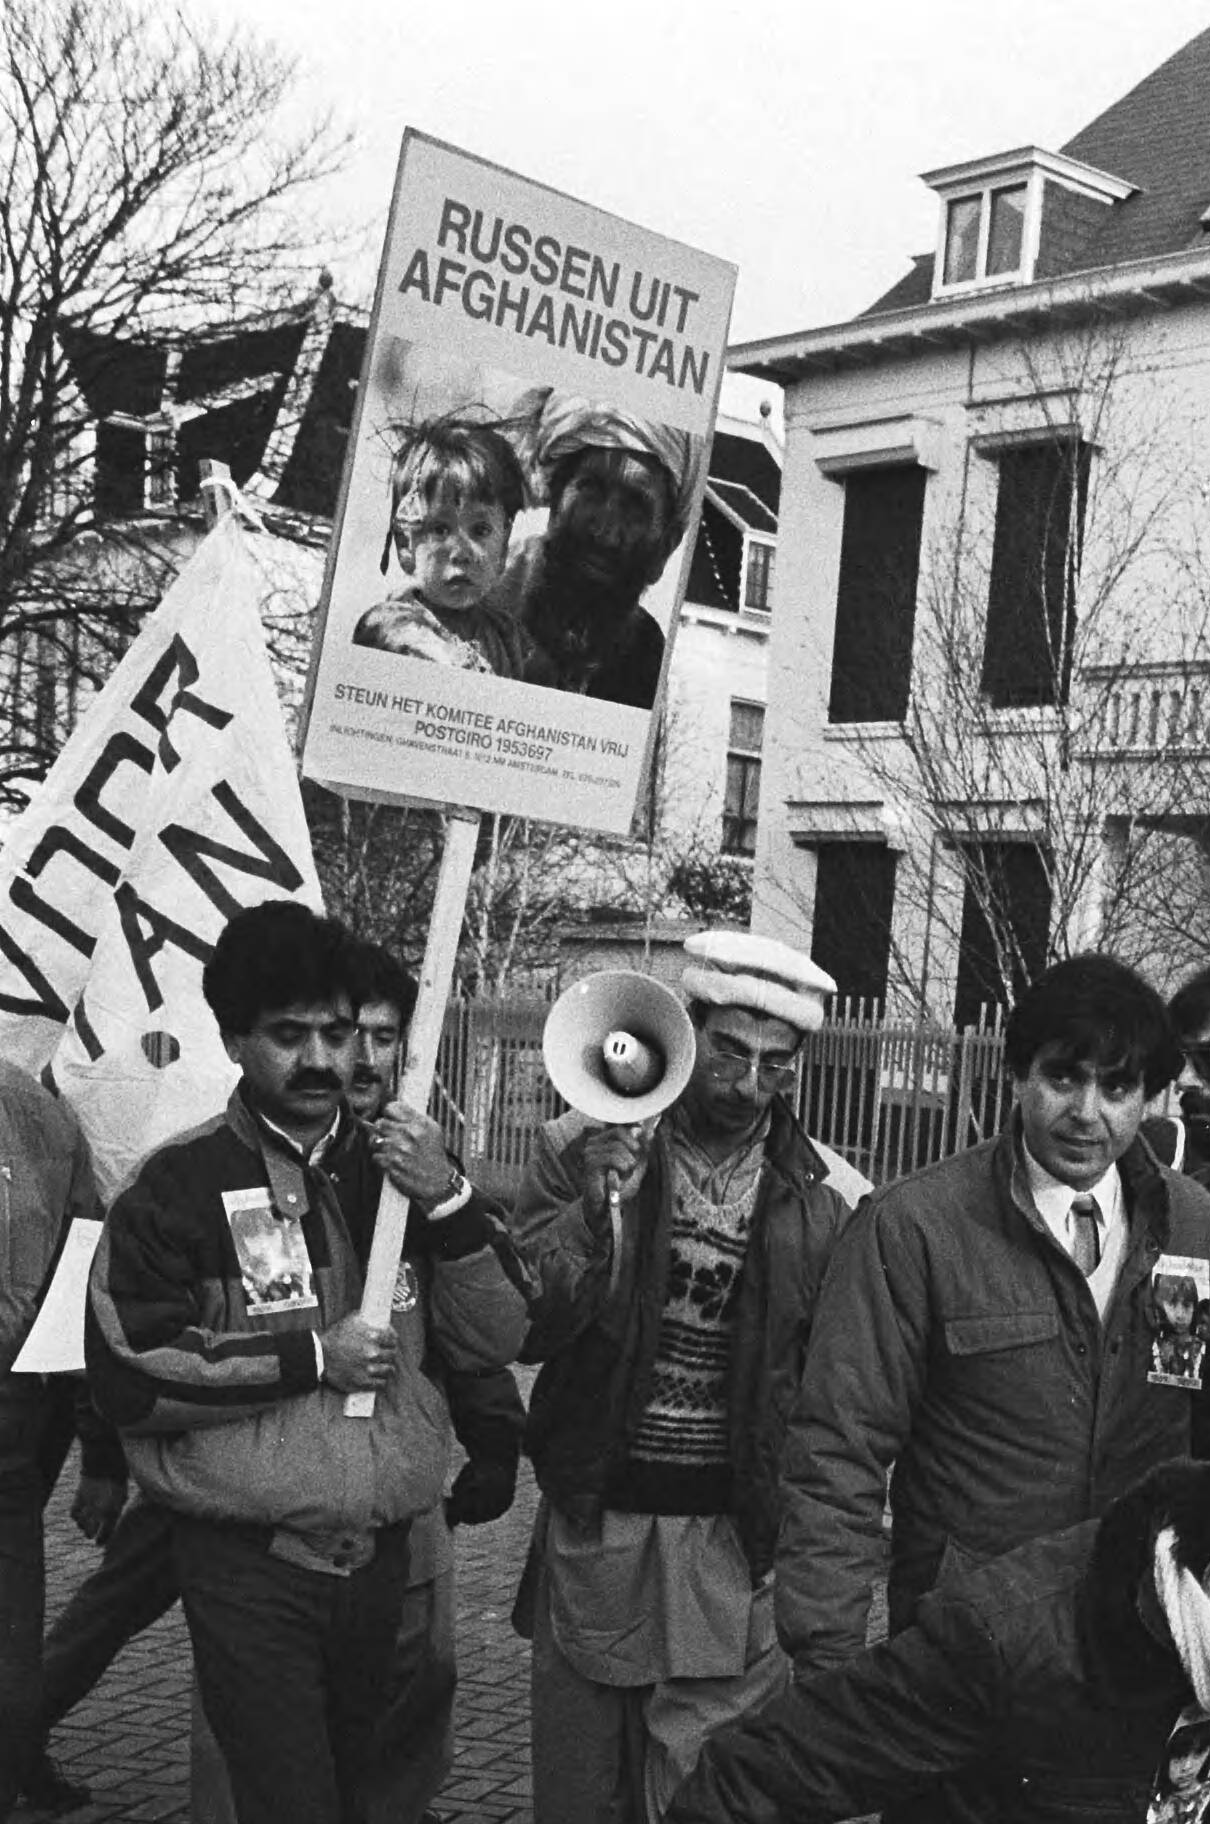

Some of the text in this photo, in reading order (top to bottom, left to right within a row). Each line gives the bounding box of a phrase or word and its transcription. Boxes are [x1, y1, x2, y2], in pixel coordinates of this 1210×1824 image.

[437, 197, 700, 333] RUSSEN UIT
[398, 249, 710, 394] AFGHANISTAN
[334, 683, 629, 758] STEUN HET KOMITEE AFGHANISTAN VRIJ
[414, 720, 493, 749] POSTGIRO
